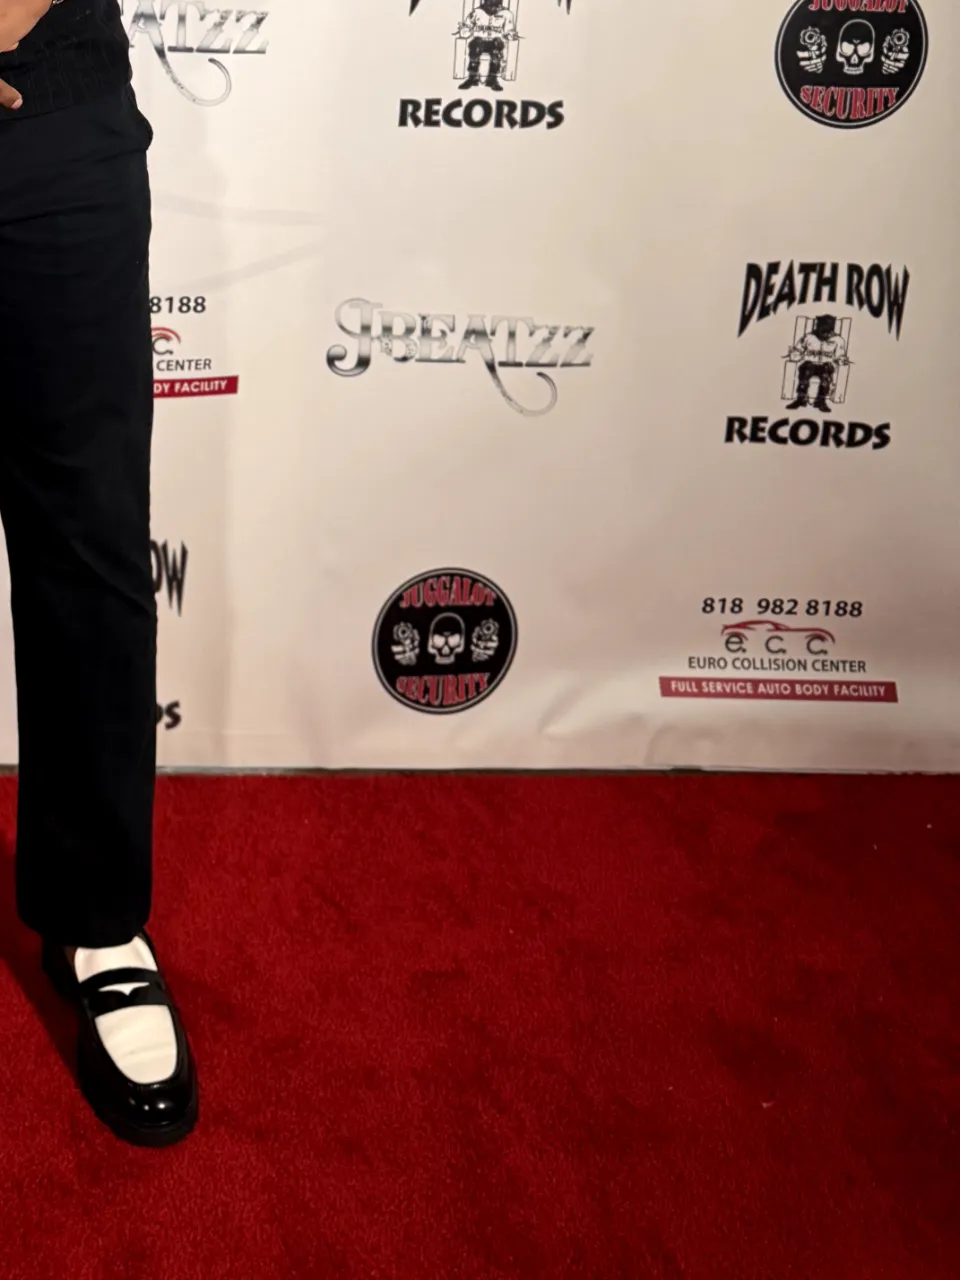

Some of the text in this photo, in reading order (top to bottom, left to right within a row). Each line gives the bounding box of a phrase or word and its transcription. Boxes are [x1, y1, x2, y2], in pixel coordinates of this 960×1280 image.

[398, 98, 564, 130] RECORDS
[800, 85, 899, 119] SECURITY
[150, 296, 206, 314] 8188
[737, 259, 910, 341] DEATH ROW
[156, 358, 212, 371] CENTER
[326, 297, 595, 417] JBEATZZ
[154, 380, 227, 394] DY FACILITY
[724, 416, 891, 450] RECORDS
[399, 576, 497, 608] JUGGALOT
[702, 597, 863, 618] 818 982 8188
[688, 657, 866, 672] EURO COLLISION CENTER
[396, 672, 490, 706] SECURITY
[671, 680, 886, 697] FULL SERVICE AUTO BODY FACILITY
